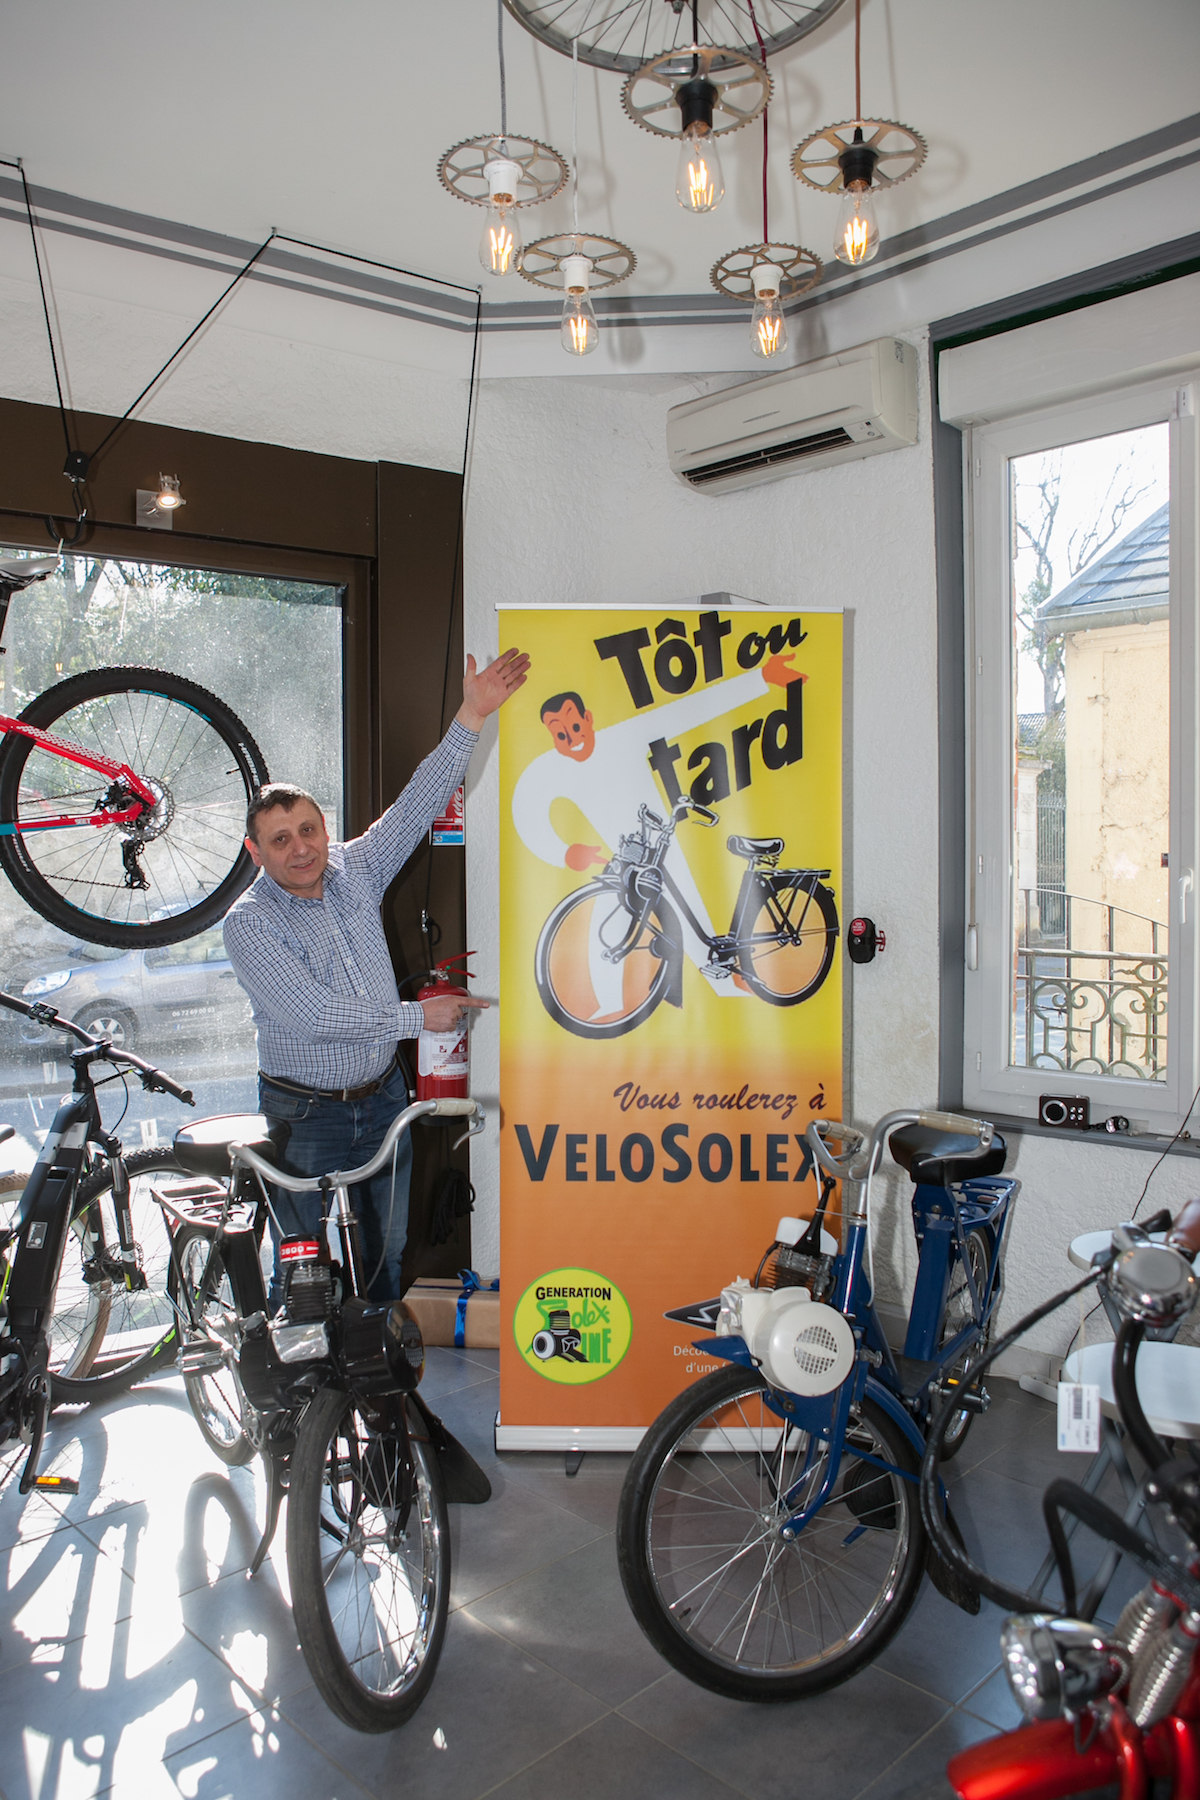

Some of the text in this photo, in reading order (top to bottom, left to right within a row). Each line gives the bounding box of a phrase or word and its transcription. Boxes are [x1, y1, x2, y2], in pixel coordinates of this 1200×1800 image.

[593, 611, 807, 709] Tôt ou
[648, 677, 803, 822] tard
[613, 1082, 828, 1120] Vous roulerez à
[535, 1286, 611, 1300] GENERATION
